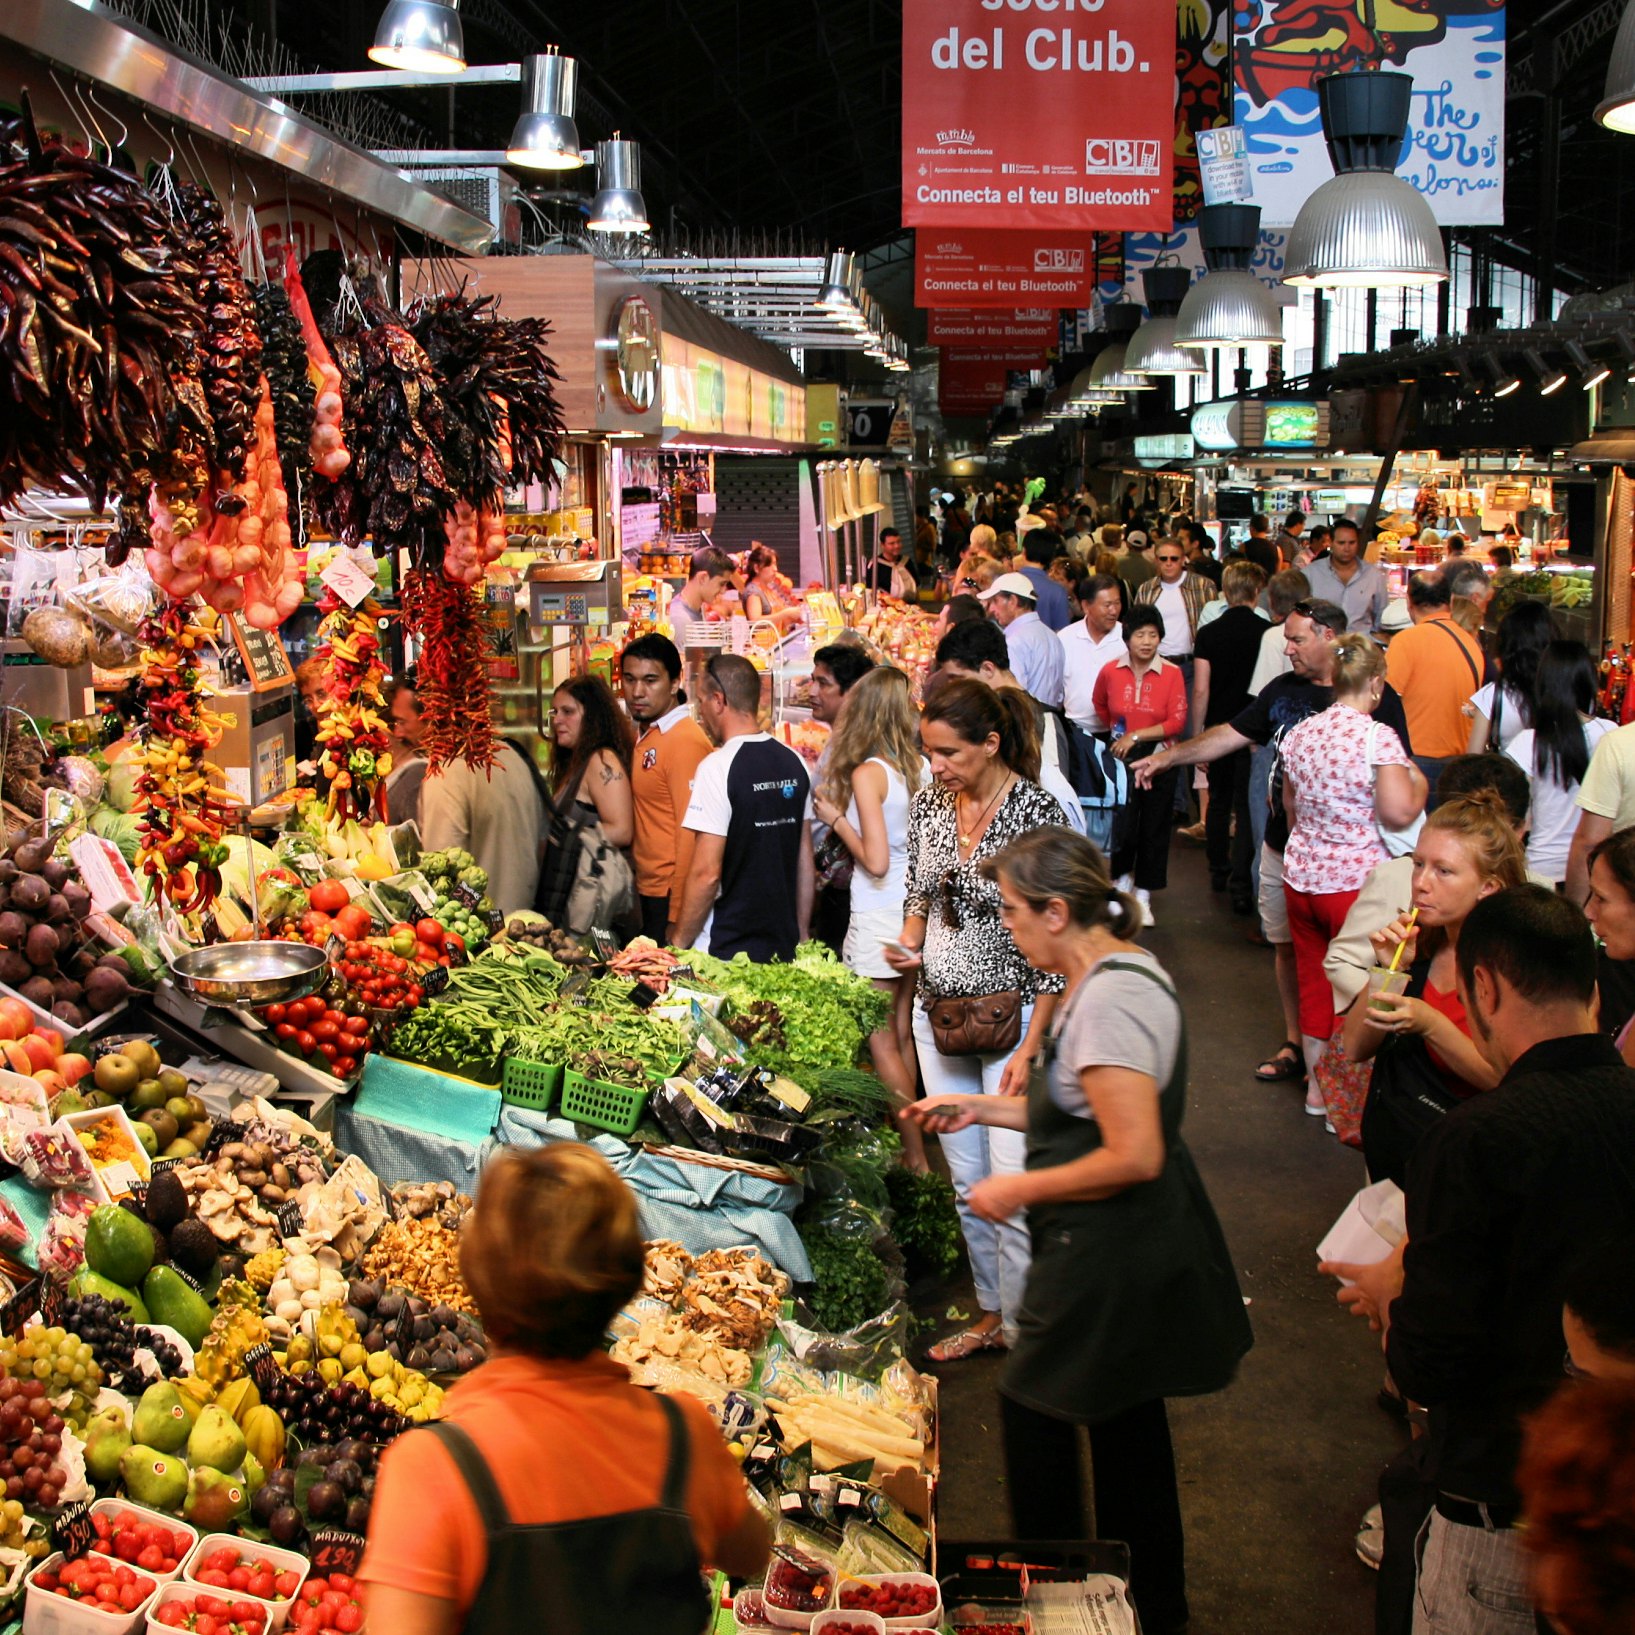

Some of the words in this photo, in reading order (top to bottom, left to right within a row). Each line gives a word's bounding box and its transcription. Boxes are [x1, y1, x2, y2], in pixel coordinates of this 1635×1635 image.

[931, 27, 1003, 70] del
[1025, 28, 1150, 73] Club.
[1411, 80, 1480, 130] The
[916, 147, 946, 155] Mercats
[947, 147, 957, 155] de
[958, 147, 993, 155] Barcelona
[1481, 135, 1498, 168] of
[916, 185, 1001, 204] Connecta
[1007, 186, 1023, 203] el
[1029, 187, 1058, 204] teu
[924, 278, 979, 291] Connecta
[982, 279, 993, 291] el
[997, 280, 1016, 292] teu
[934, 326, 974, 335] Connecta
